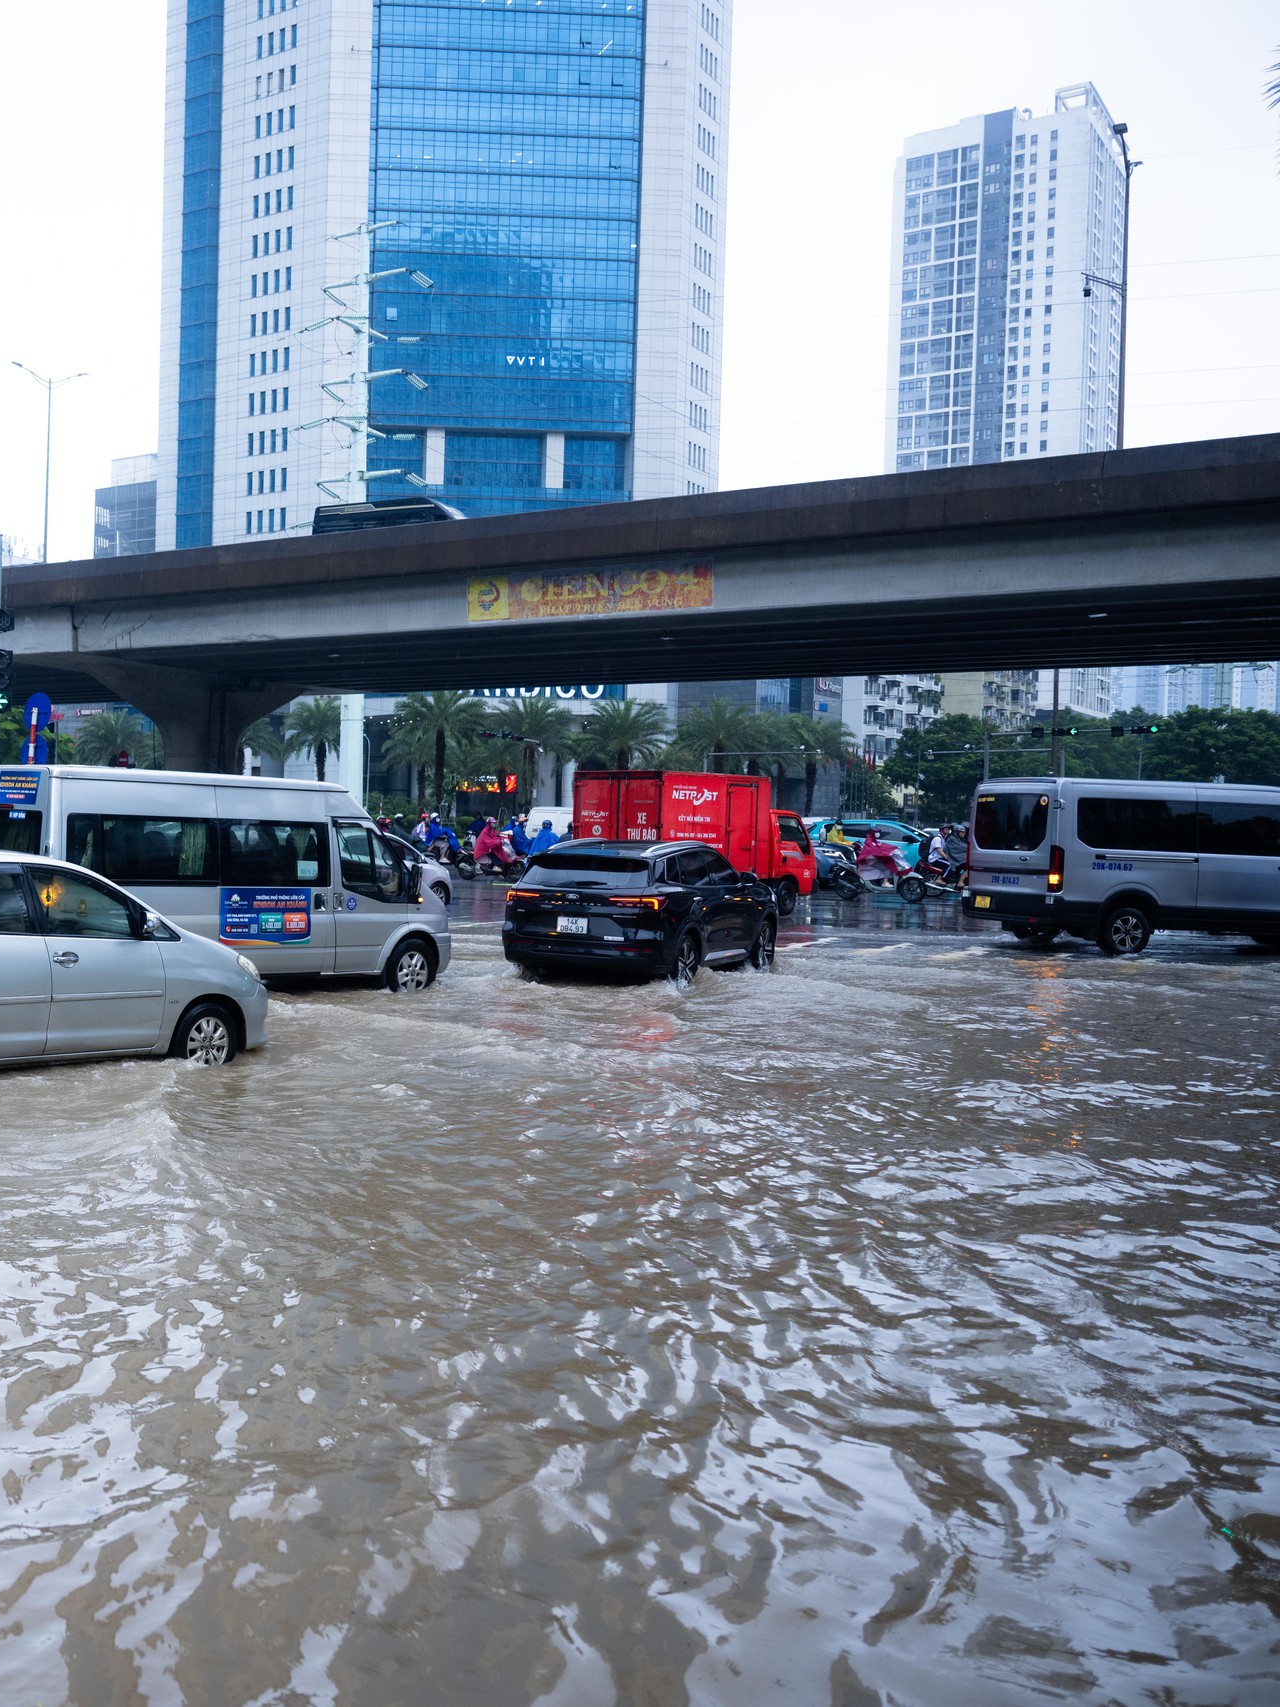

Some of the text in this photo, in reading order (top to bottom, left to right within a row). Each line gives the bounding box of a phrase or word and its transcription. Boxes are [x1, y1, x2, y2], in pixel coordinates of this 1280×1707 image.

[672, 788, 718, 806] NETPOST
[637, 812, 647, 825] XE
[627, 827, 657, 841] THƯ BÁO
[1092, 861, 1133, 871] 29K-074.62
[566, 918, 580, 926] 14K
[560, 924, 584, 934] 084.93
